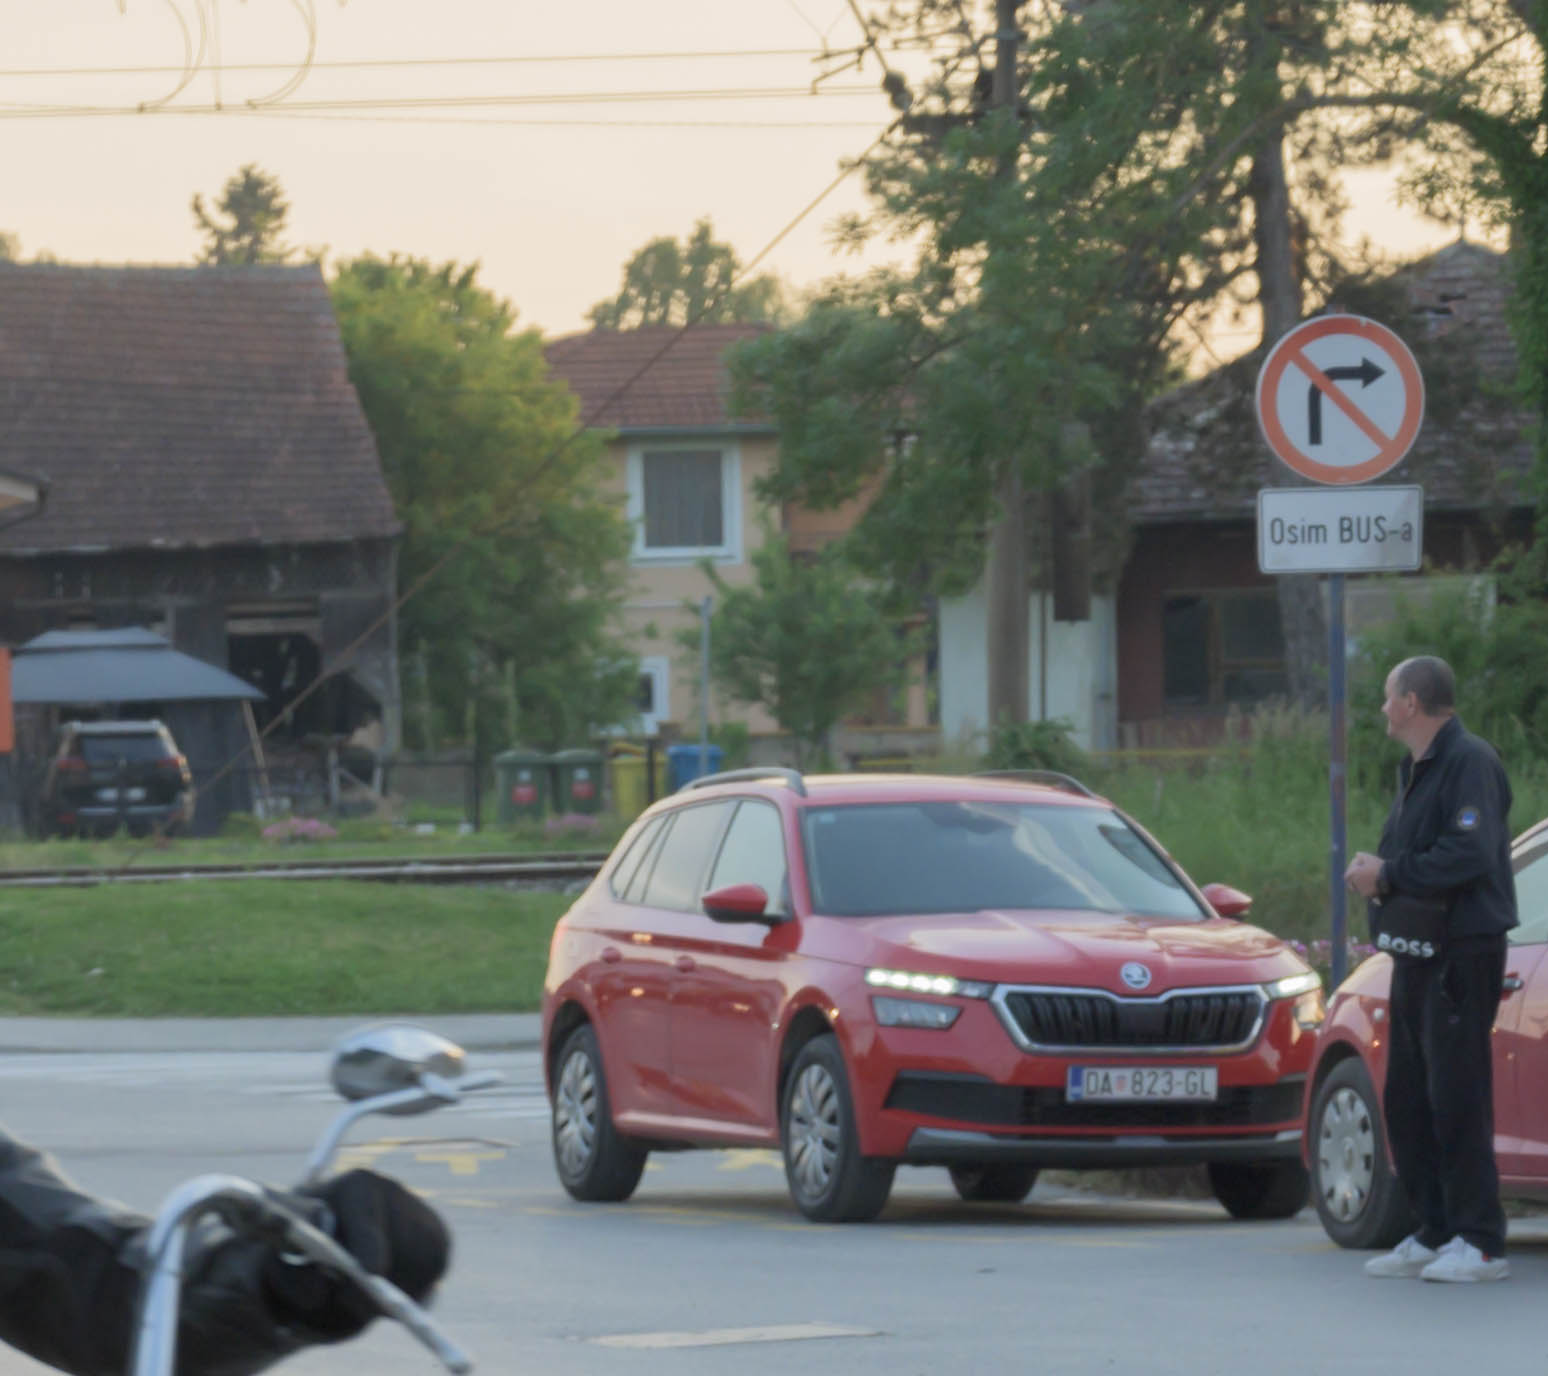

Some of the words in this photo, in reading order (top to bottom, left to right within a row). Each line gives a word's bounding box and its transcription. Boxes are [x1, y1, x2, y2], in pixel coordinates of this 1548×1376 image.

[1270, 516, 1328, 545] Osim
[1338, 515, 1414, 544] BUS-a
[1377, 932, 1435, 958] BOSS
